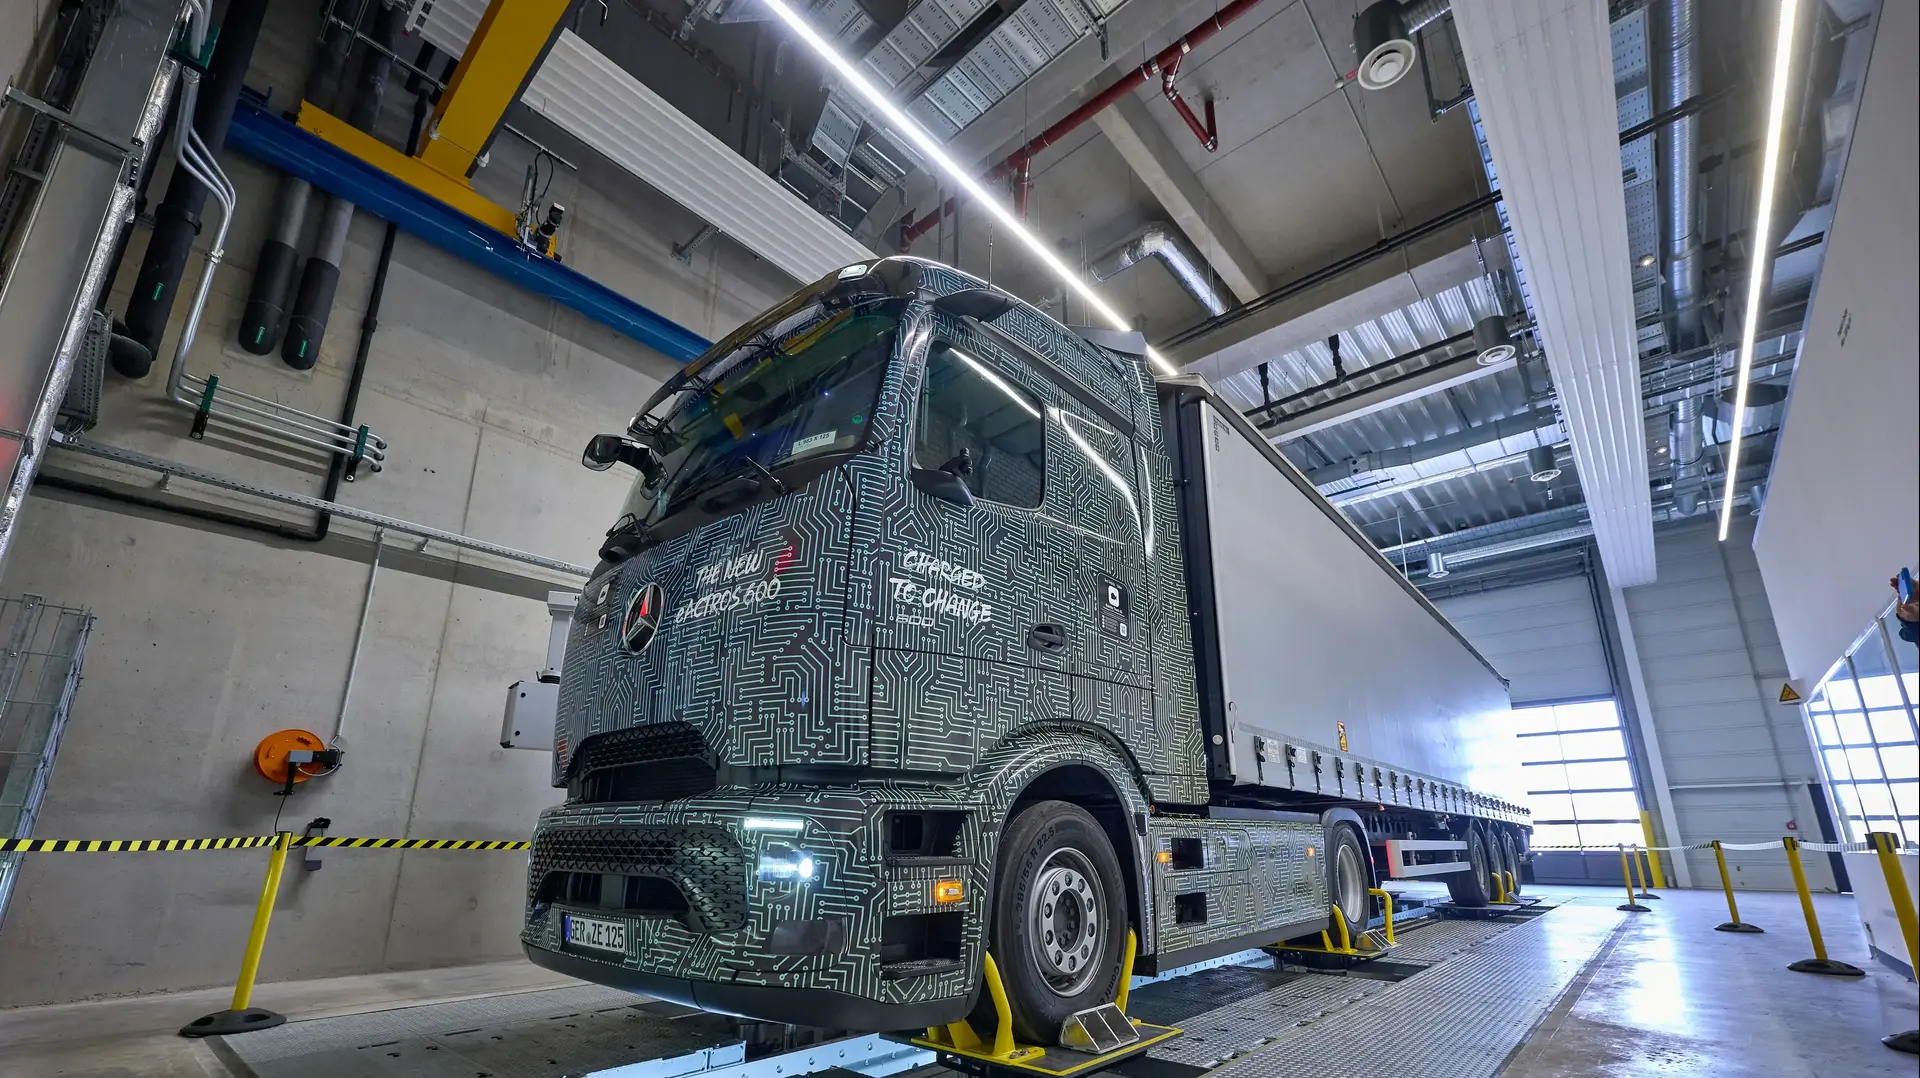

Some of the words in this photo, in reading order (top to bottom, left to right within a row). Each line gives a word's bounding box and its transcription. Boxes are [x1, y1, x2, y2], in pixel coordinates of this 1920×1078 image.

[695, 565, 719, 589] THE
[723, 550, 764, 581] NEW
[903, 551, 986, 590] CHARGED
[743, 578, 781, 605] 600
[889, 577, 917, 602] TO
[922, 588, 992, 625] CHANGE
[1016, 859, 1032, 911] 385/55
[1030, 848, 1038, 859] R
[1037, 826, 1054, 850] 22.5
[571, 920, 585, 942] GER
[592, 923, 603, 945] ZE
[605, 925, 623, 948] 125
